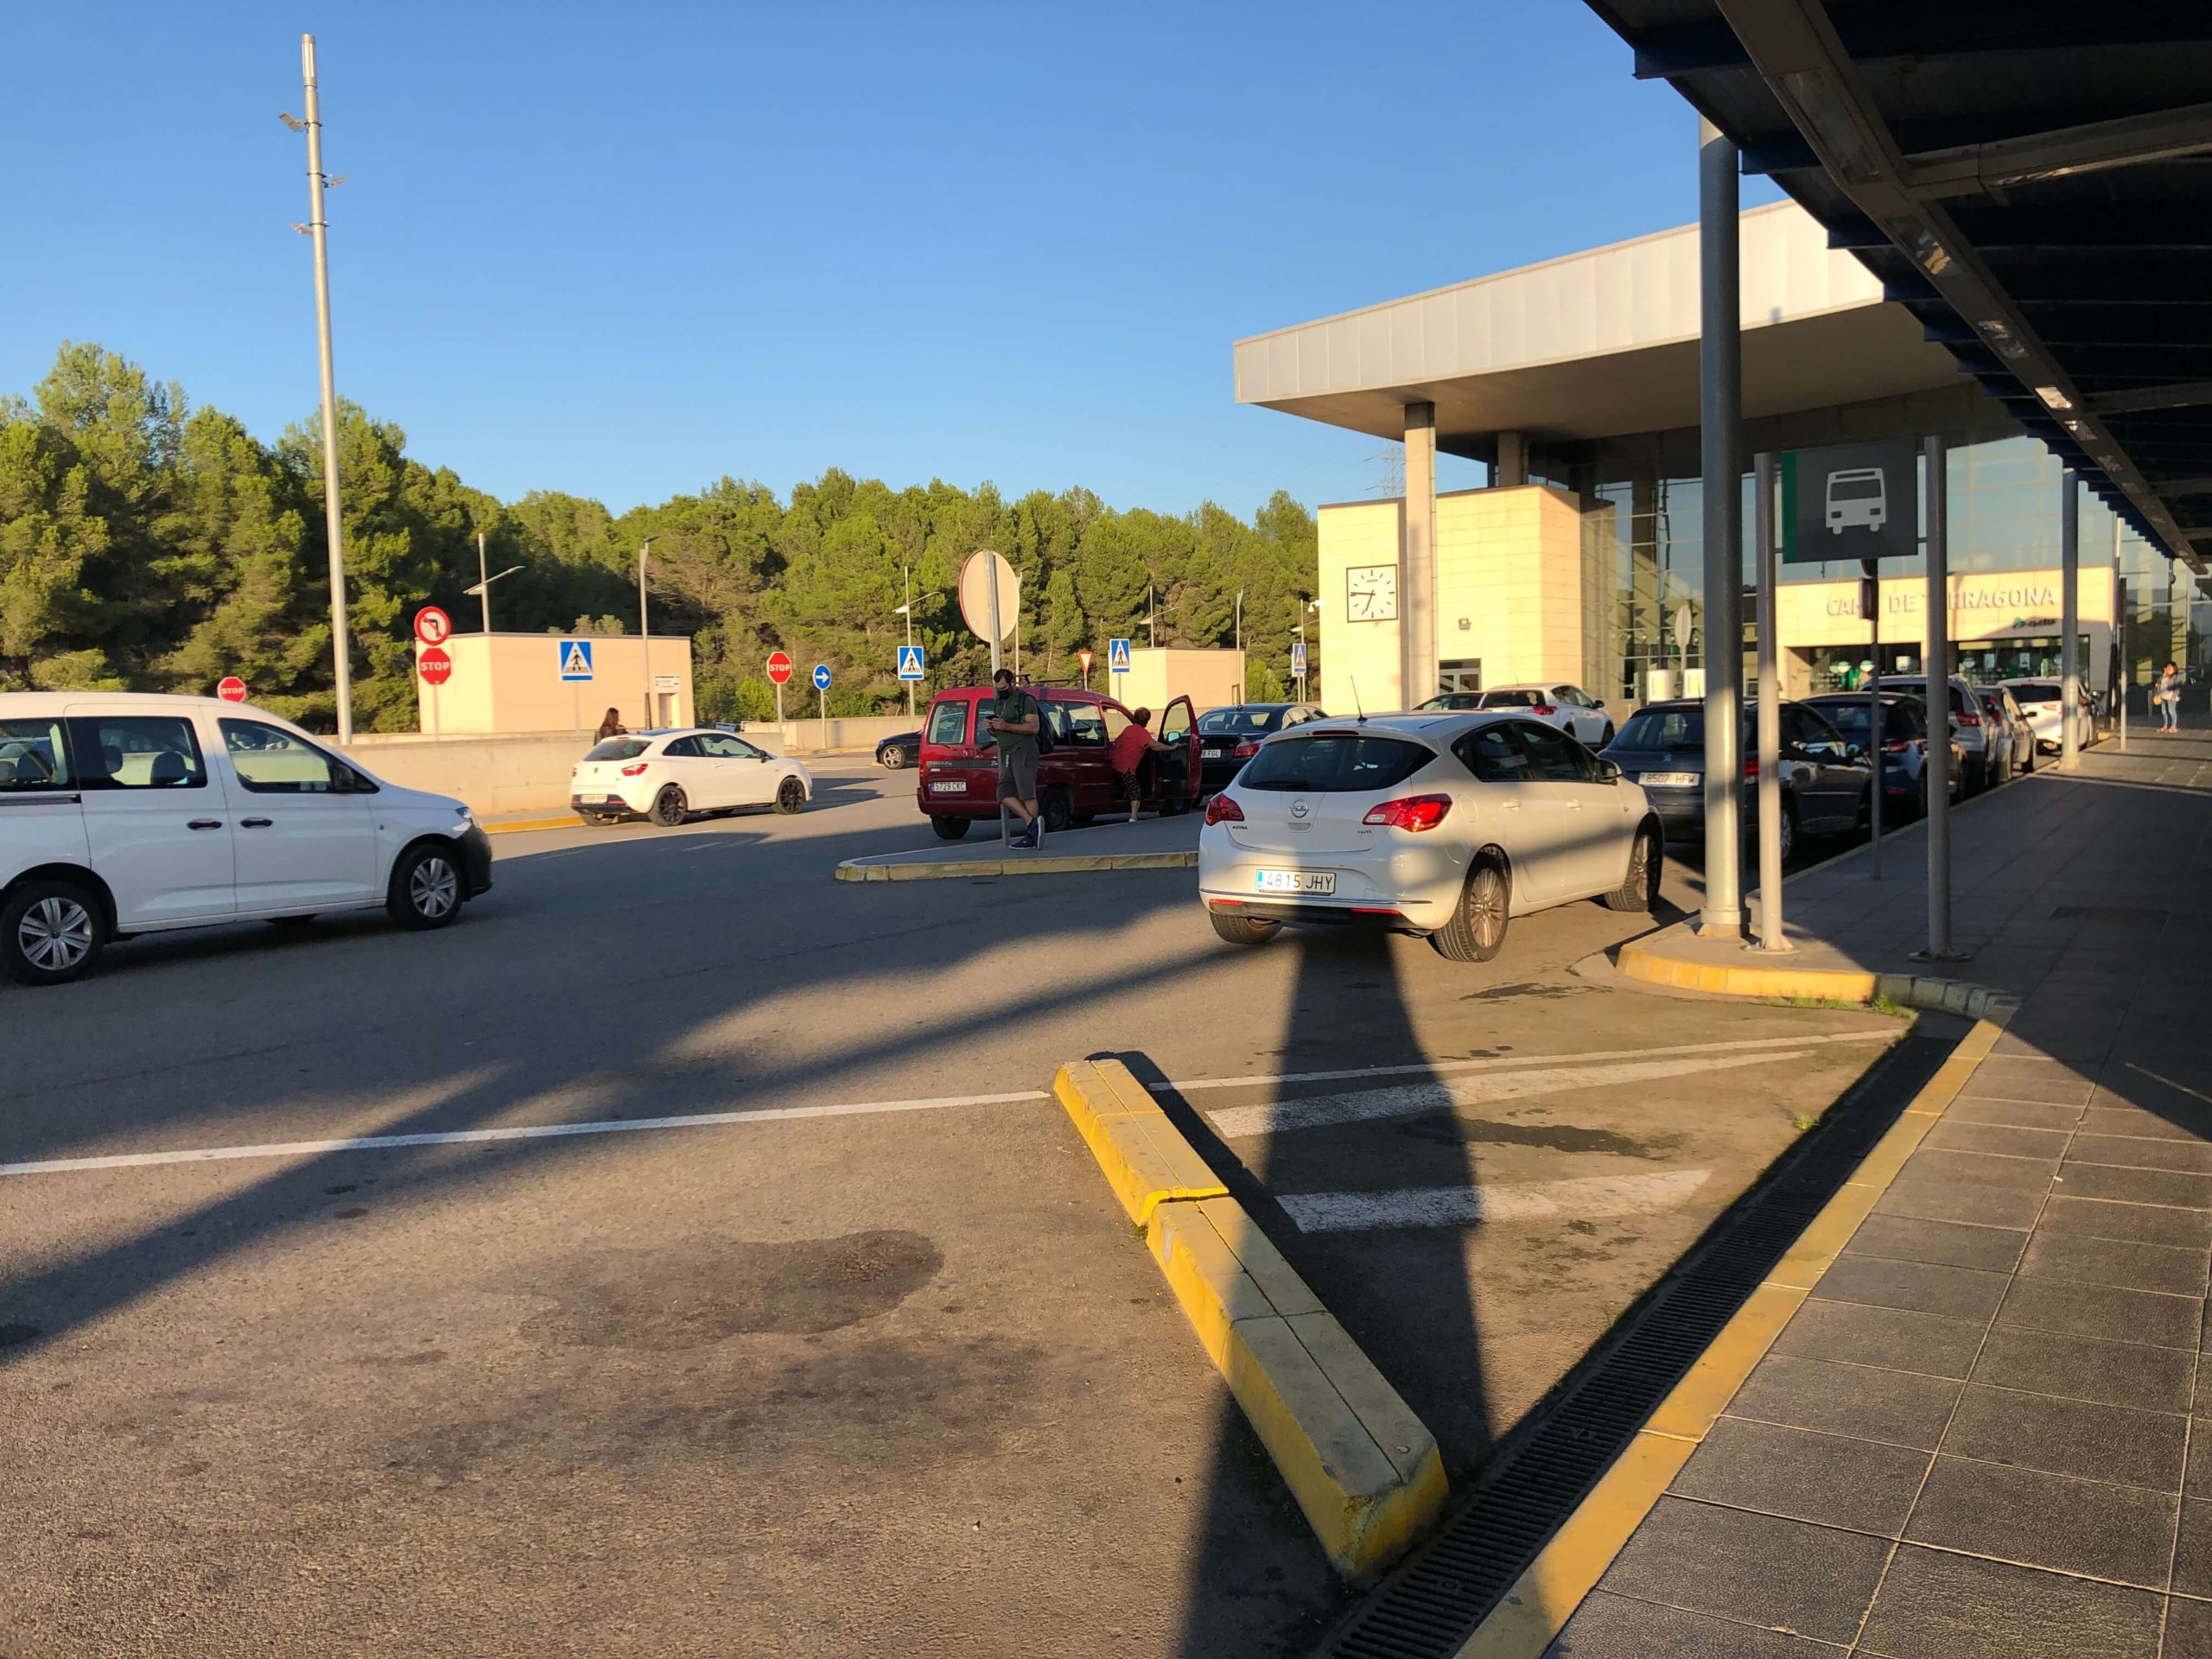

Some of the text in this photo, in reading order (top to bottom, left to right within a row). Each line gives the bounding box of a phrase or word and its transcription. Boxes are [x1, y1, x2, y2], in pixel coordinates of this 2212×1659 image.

[1889, 594, 1916, 613] DE
[1922, 587, 2055, 610] RRAGONA
[420, 661, 450, 671] STOP
[769, 664, 791, 672] STOP
[935, 781, 951, 791] 5729
[1267, 873, 1333, 890] 4815 JHY
